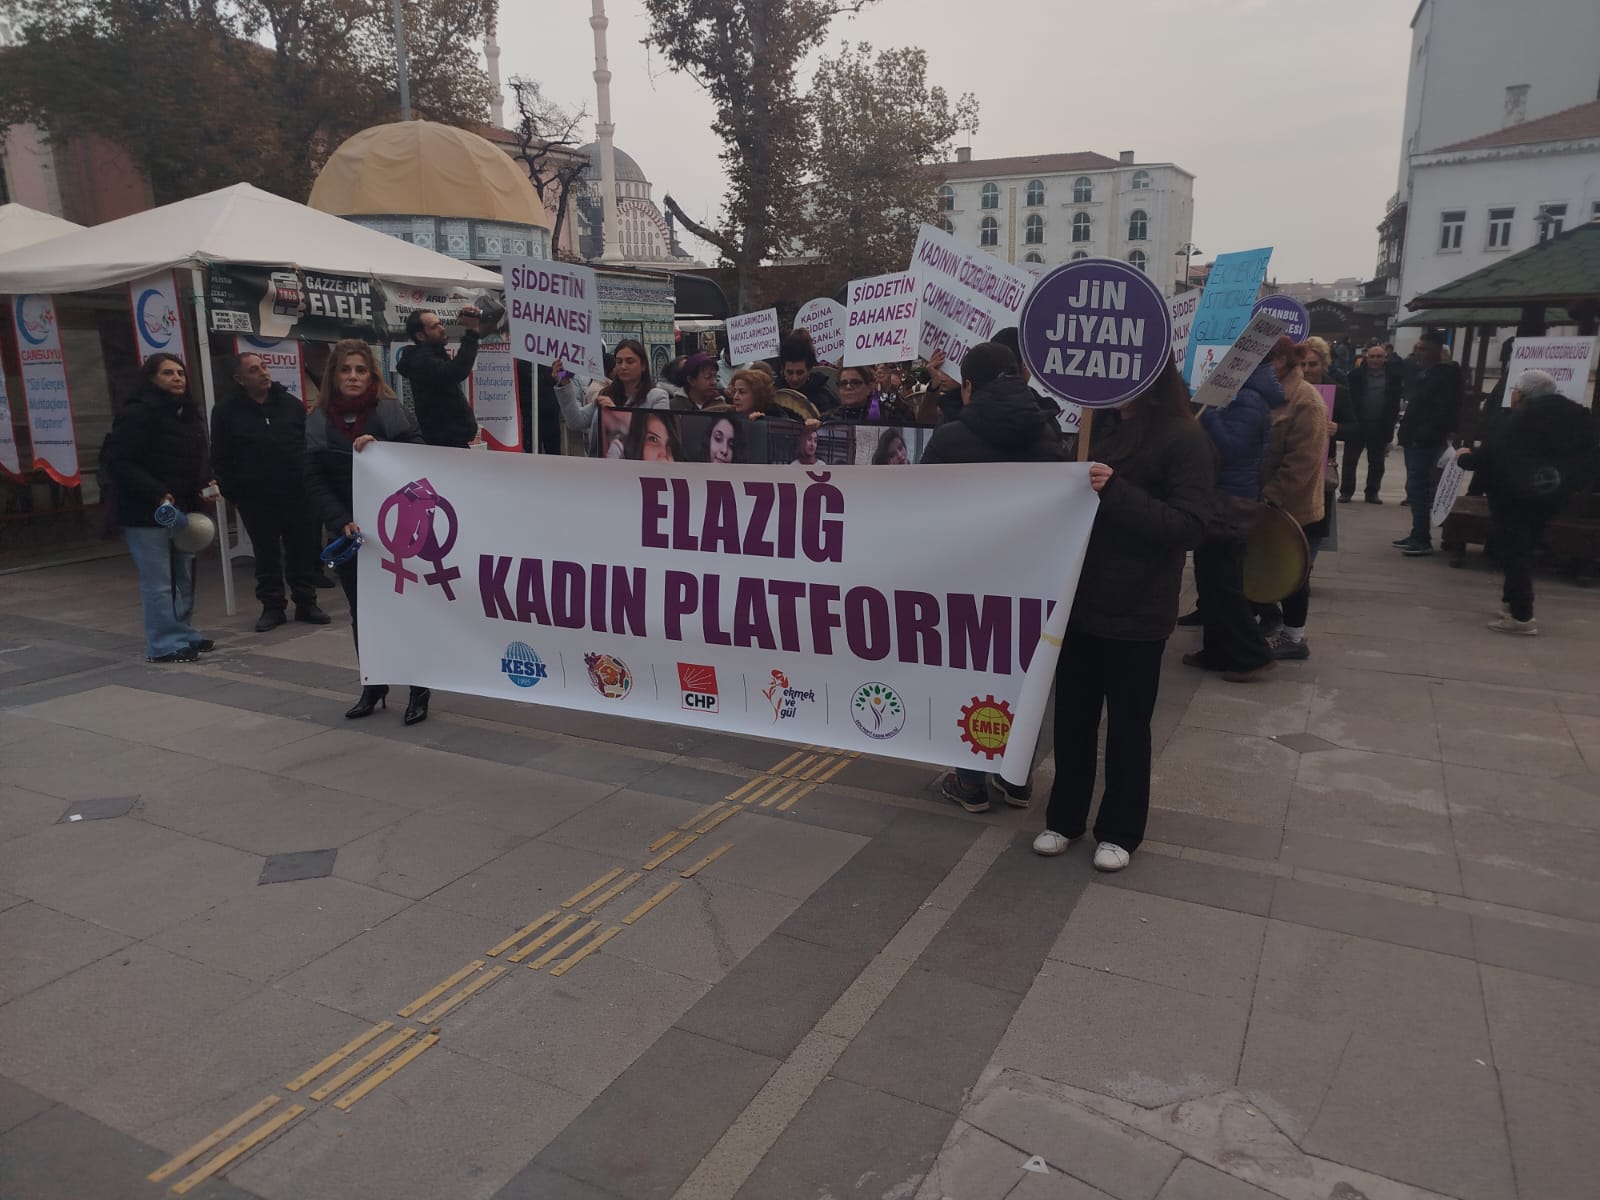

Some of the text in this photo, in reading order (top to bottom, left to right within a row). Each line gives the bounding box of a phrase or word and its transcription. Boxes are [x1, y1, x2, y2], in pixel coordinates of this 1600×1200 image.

[918, 239, 962, 278] KADININ
[306, 276, 343, 292] GAZZE
[512, 264, 585, 299] ŞİDDETİN
[853, 275, 916, 304] ŞİDDETİN
[309, 293, 373, 320] ELELE
[513, 299, 592, 335] BAHANESİ
[801, 306, 832, 323] KADINA
[849, 298, 918, 327] BAHANESİ
[922, 282, 996, 340] CUMHURİYETİN
[812, 328, 841, 345] SANLIK
[855, 328, 907, 350] OLMAZ!
[525, 333, 585, 366] OLMAZ!
[639, 471, 844, 563] ELAZIĞ
[479, 554, 647, 638] KADIN
[501, 658, 548, 678] KESK
[685, 693, 716, 709] CHP
[783, 687, 816, 703] ekmek
[785, 699, 796, 707] ve
[780, 707, 796, 719] gül
[972, 719, 1010, 736] EMEP
